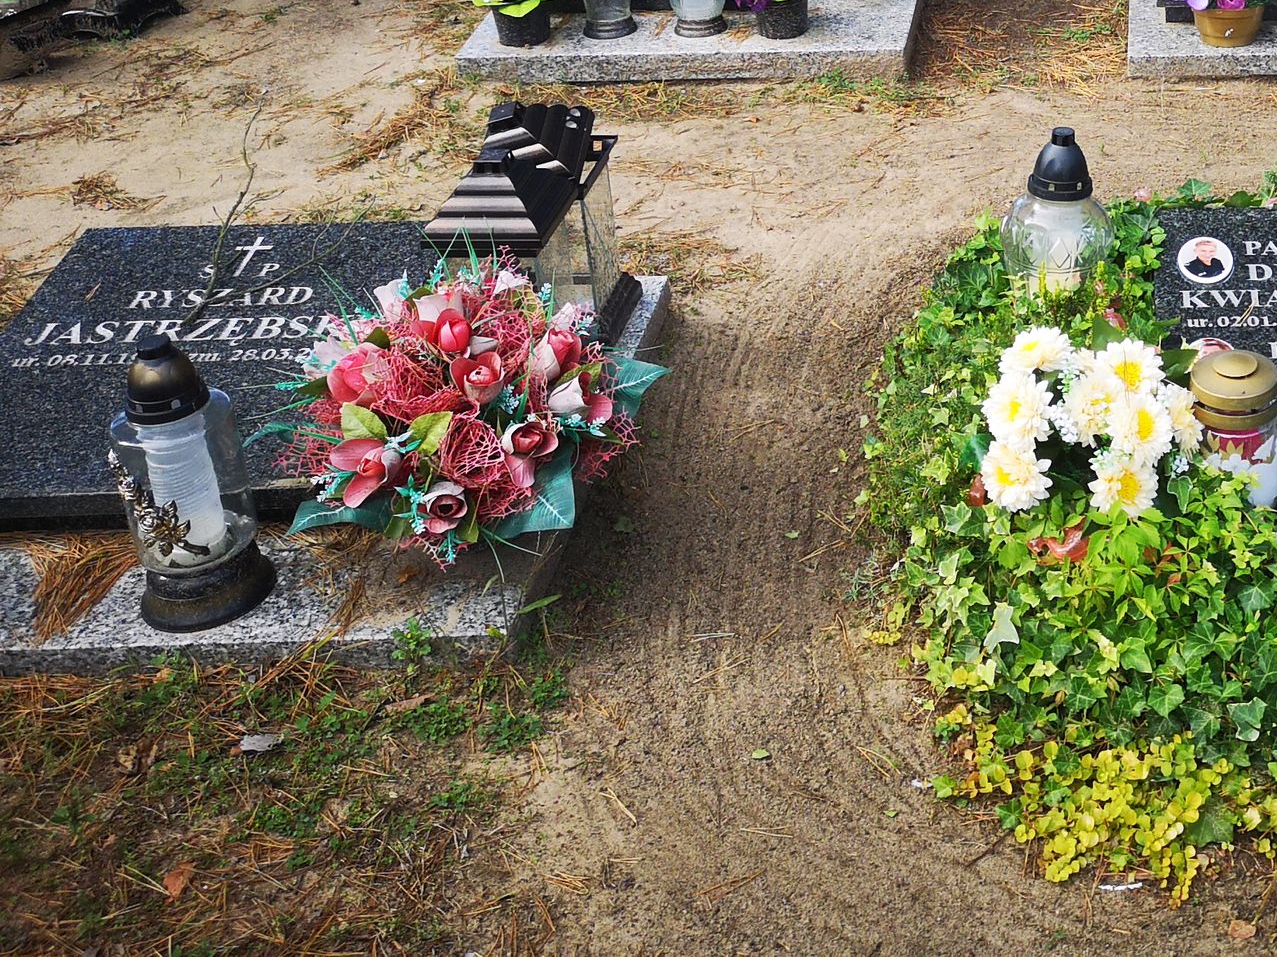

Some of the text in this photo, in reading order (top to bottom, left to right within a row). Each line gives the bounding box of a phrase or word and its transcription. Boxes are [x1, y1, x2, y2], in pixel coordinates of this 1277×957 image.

[256, 263, 281, 277] P
[126, 286, 314, 310] RYSZARD
[24, 312, 350, 346] JASTRZĘBSK
[1186, 317, 1214, 328] ur.
[12, 353, 138, 368] ur. 08.11.1
